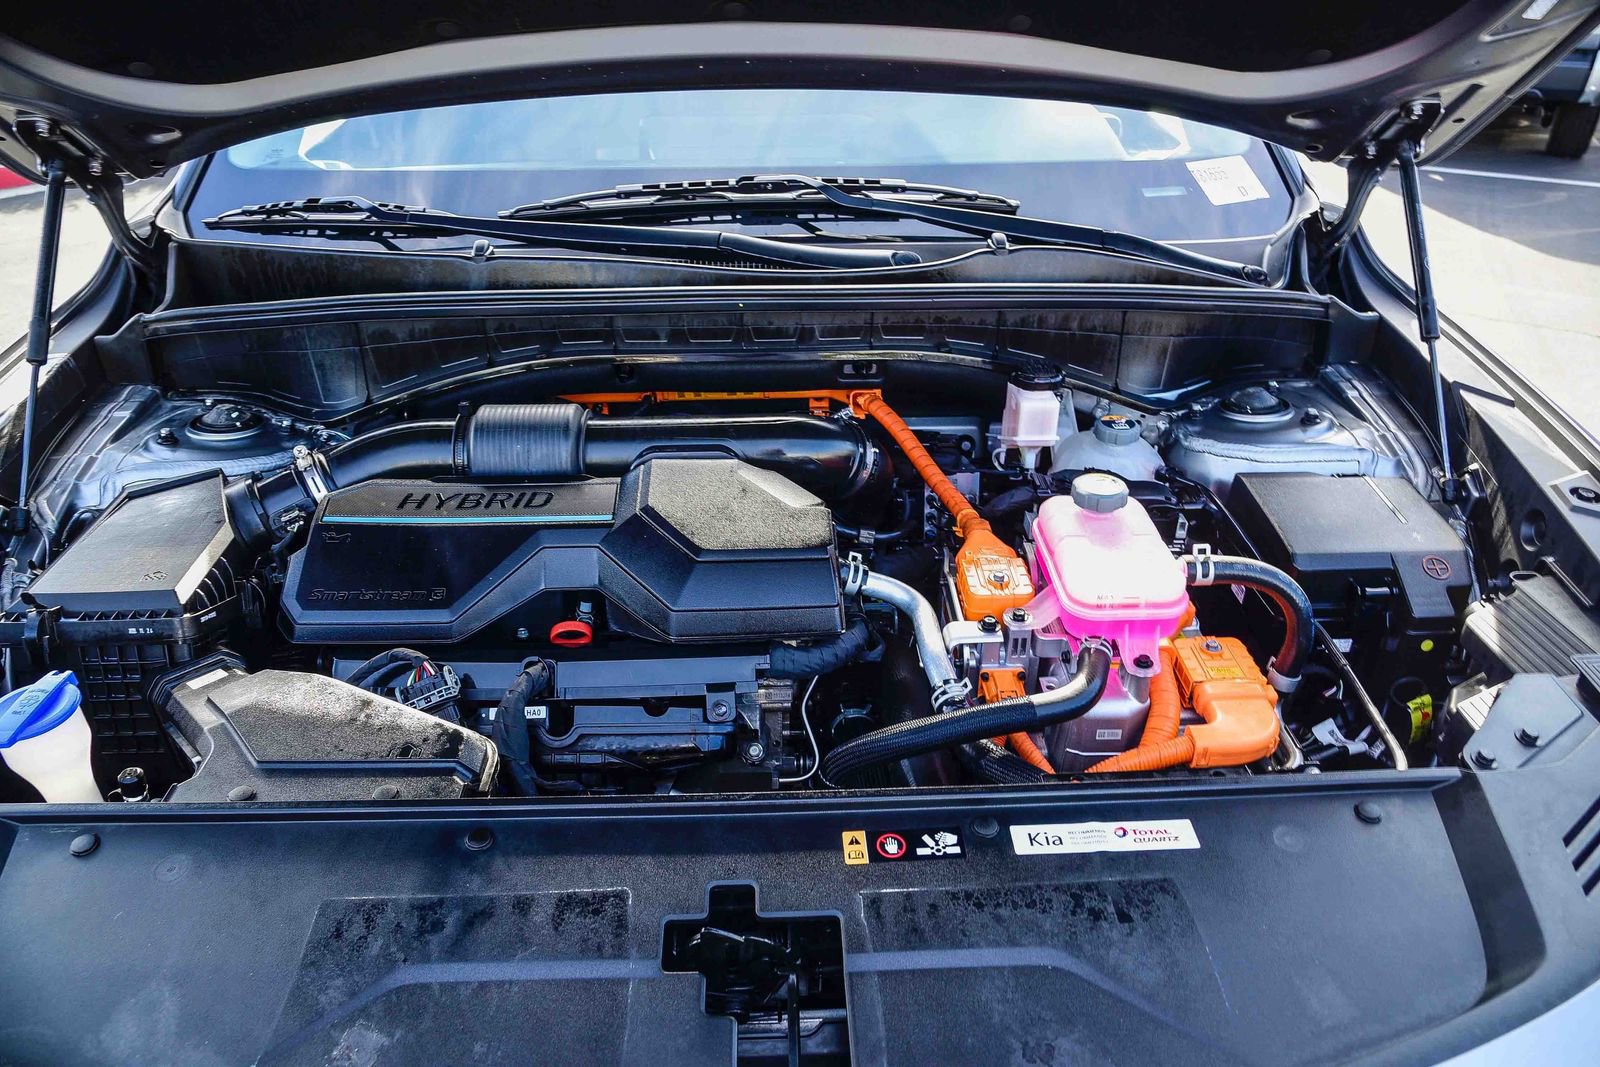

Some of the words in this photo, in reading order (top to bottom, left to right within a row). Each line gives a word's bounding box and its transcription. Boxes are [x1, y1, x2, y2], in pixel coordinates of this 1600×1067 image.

[396, 491, 555, 511] HYBRID
[308, 588, 429, 601] Smartstream
[1131, 828, 1172, 836] TOTAL
[1027, 832, 1064, 847] Kia
